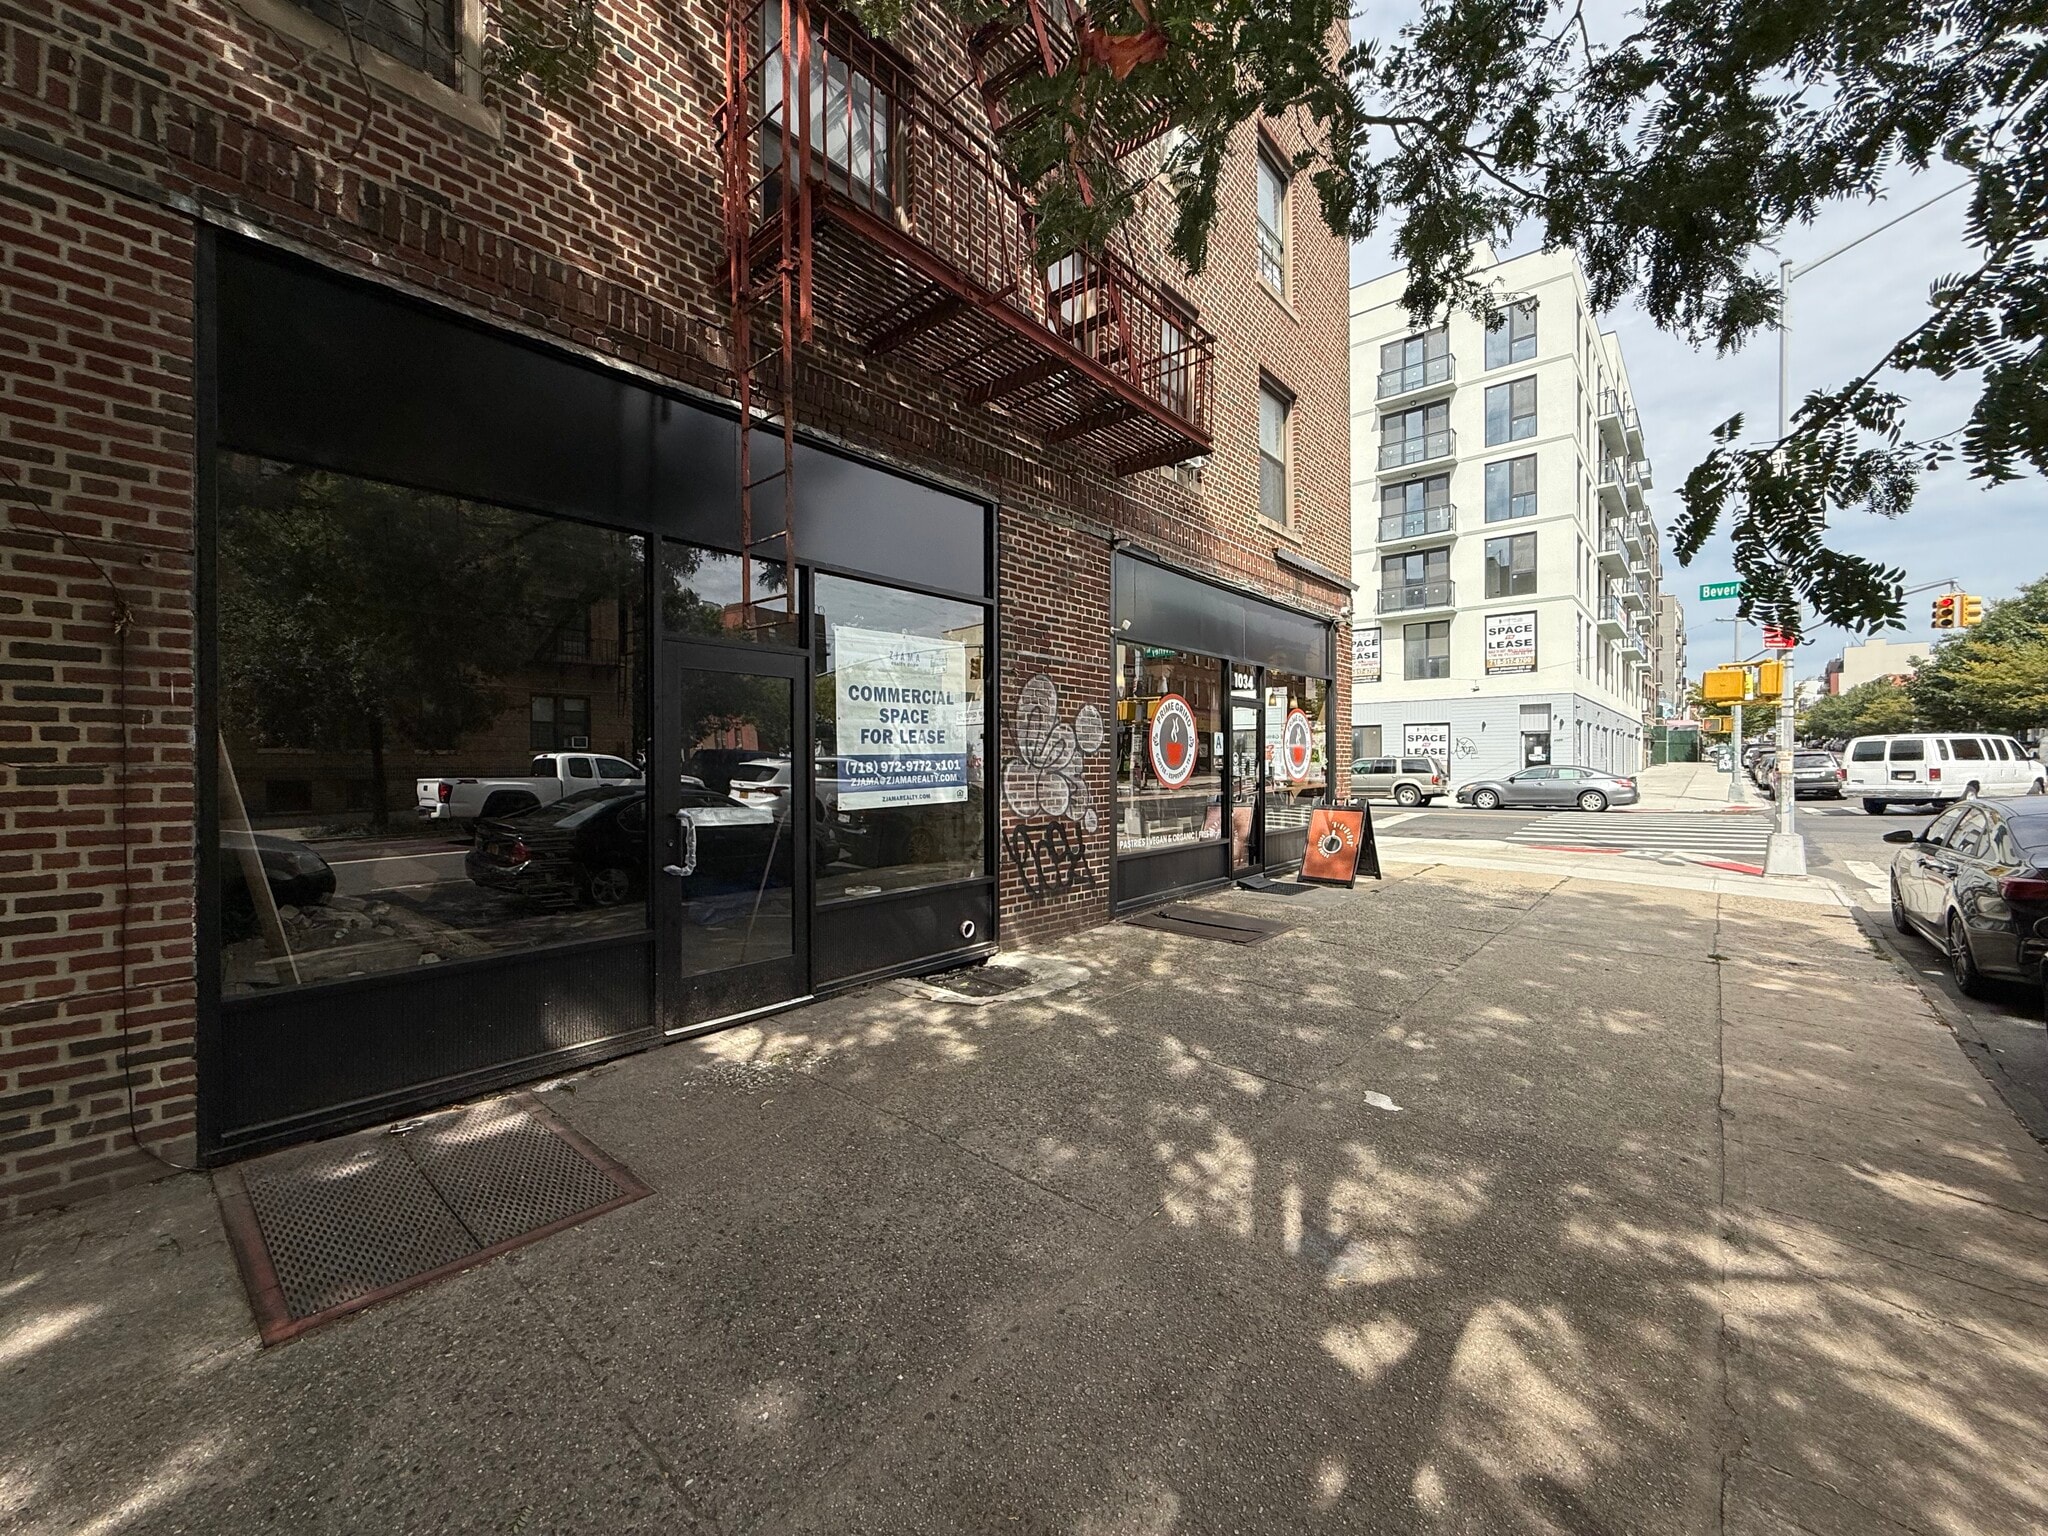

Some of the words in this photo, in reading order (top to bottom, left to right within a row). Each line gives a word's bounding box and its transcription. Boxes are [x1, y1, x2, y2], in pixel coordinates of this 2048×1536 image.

[1702, 583, 1741, 598] Beverl
[1488, 624, 1533, 636] SPACE
[1352, 639, 1379, 647] PACE
[1488, 638, 1533, 649] LEASE
[1352, 651, 1379, 660] EASE
[1233, 672, 1254, 690] 1034
[848, 684, 955, 706] COMMERCIAL
[879, 707, 930, 725] SPACE
[1156, 701, 1175, 725] PRIME
[1175, 702, 1192, 728] GRIND
[860, 728, 893, 745] FOR
[899, 729, 946, 745] LEASE
[1215, 735, 1222, 749] A
[1407, 734, 1447, 742] SPACE
[1407, 747, 1447, 756] LEASE
[845, 760, 879, 775] (718)
[881, 759, 932, 773] 972-9772
[935, 759, 961, 771] x101
[850, 774, 958, 787] ZJAMA@ZJAMAREALTY.COM
[882, 793, 931, 803] ZJAMAREALTY.COM
[1119, 838, 1146, 850] PASTRIES
[1149, 834, 1168, 846] VEGAN
[1172, 831, 1195, 842] ORGANIC
